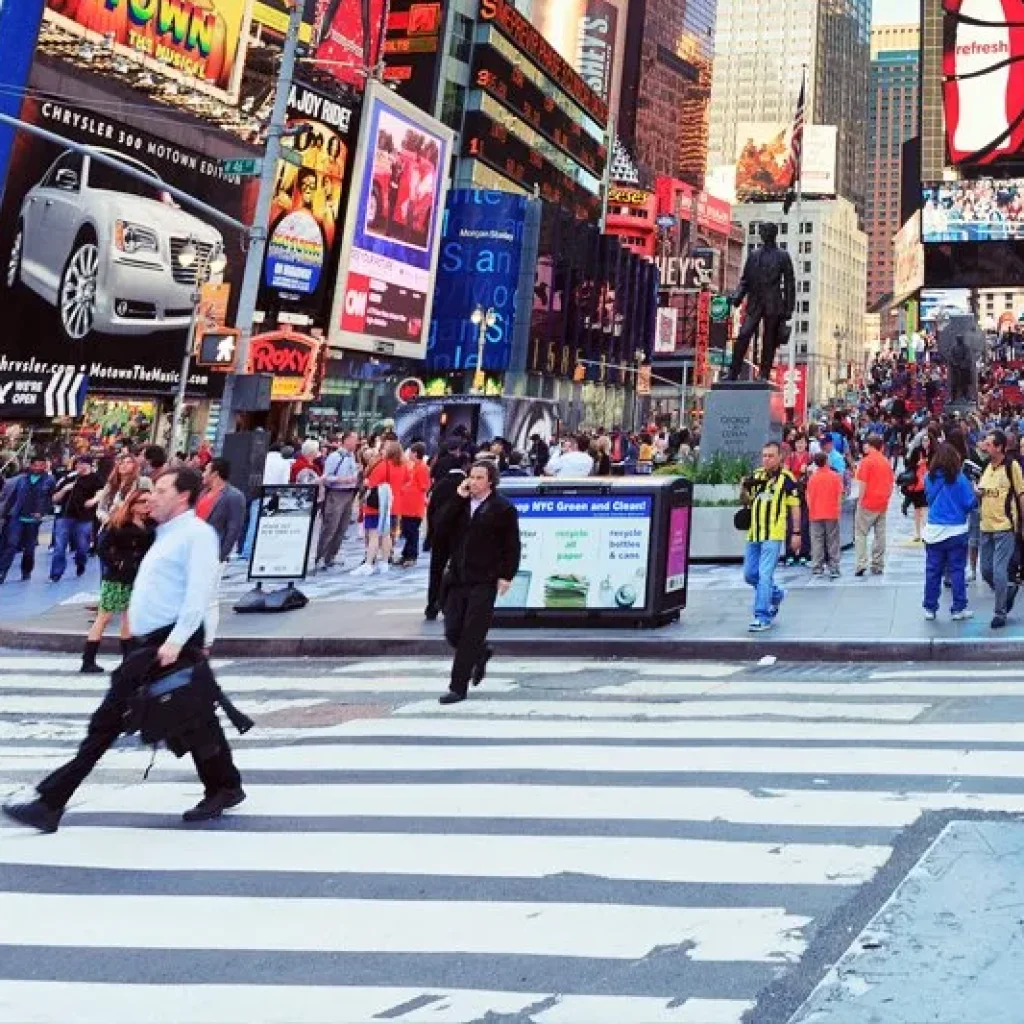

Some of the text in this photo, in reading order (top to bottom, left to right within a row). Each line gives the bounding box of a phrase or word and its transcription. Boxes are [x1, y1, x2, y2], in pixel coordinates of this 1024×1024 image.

[956, 40, 1008, 55] refresh
[298, 91, 322, 117] JOY
[41, 103, 113, 139] CHRYSLER
[147, 142, 197, 170] MOTOWN
[460, 228, 489, 238] Morgan
[650, 256, 706, 284] HEY'S
[90, 362, 208, 385] MotownTheMusic.com
[12, 394, 37, 404] OPEN
[532, 501, 554, 511] NYC
[557, 501, 588, 511] Green
[590, 501, 610, 511] and
[612, 501, 646, 511] Clean!
[609, 529, 642, 538] recycle
[609, 540, 640, 548] bottles
